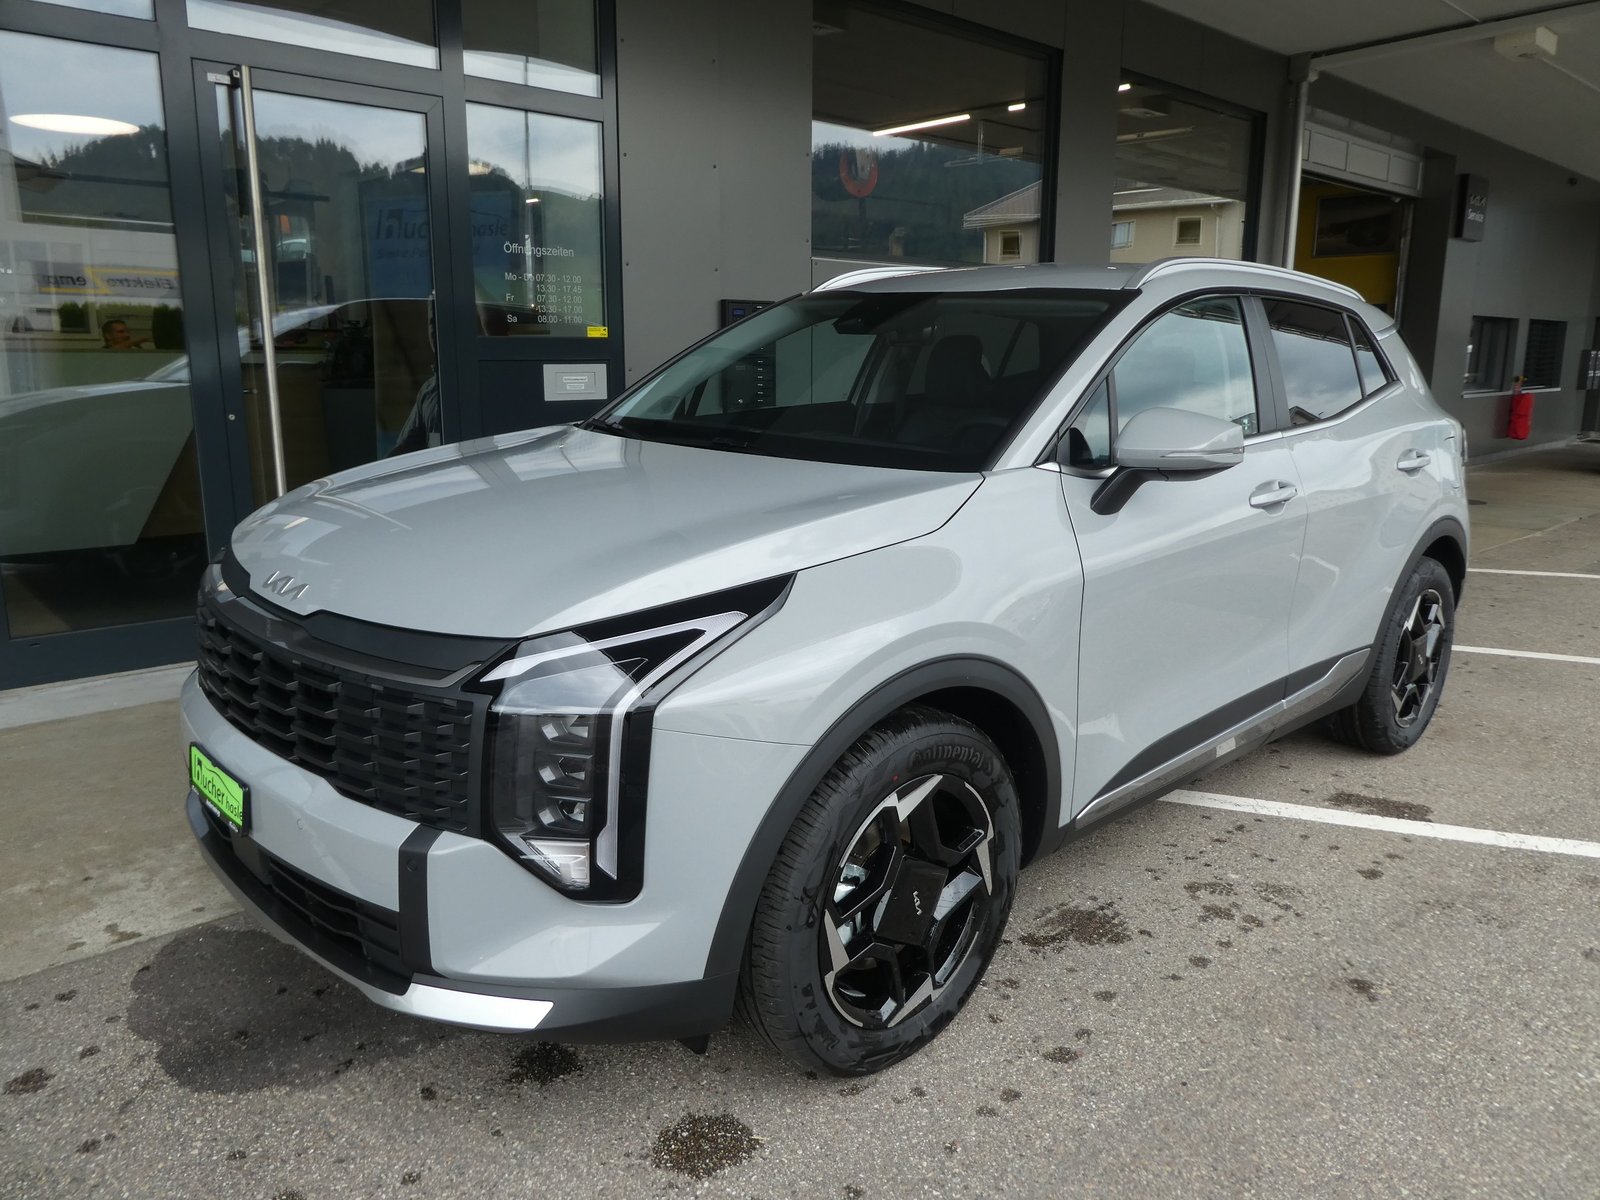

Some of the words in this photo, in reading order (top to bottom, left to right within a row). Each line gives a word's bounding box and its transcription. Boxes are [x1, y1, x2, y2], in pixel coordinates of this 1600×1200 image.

[503, 241, 574, 257] Öffnungszeiten
[505, 272, 517, 281] Mo
[535, 274, 556, 282] 07.30
[562, 275, 582, 283] 12.00
[536, 284, 556, 292] 13.30
[562, 285, 582, 294] 17.45
[505, 293, 514, 302] Fr
[537, 305, 557, 313] 13.30
[507, 315, 518, 323] Sa
[537, 315, 558, 323] 08.00
